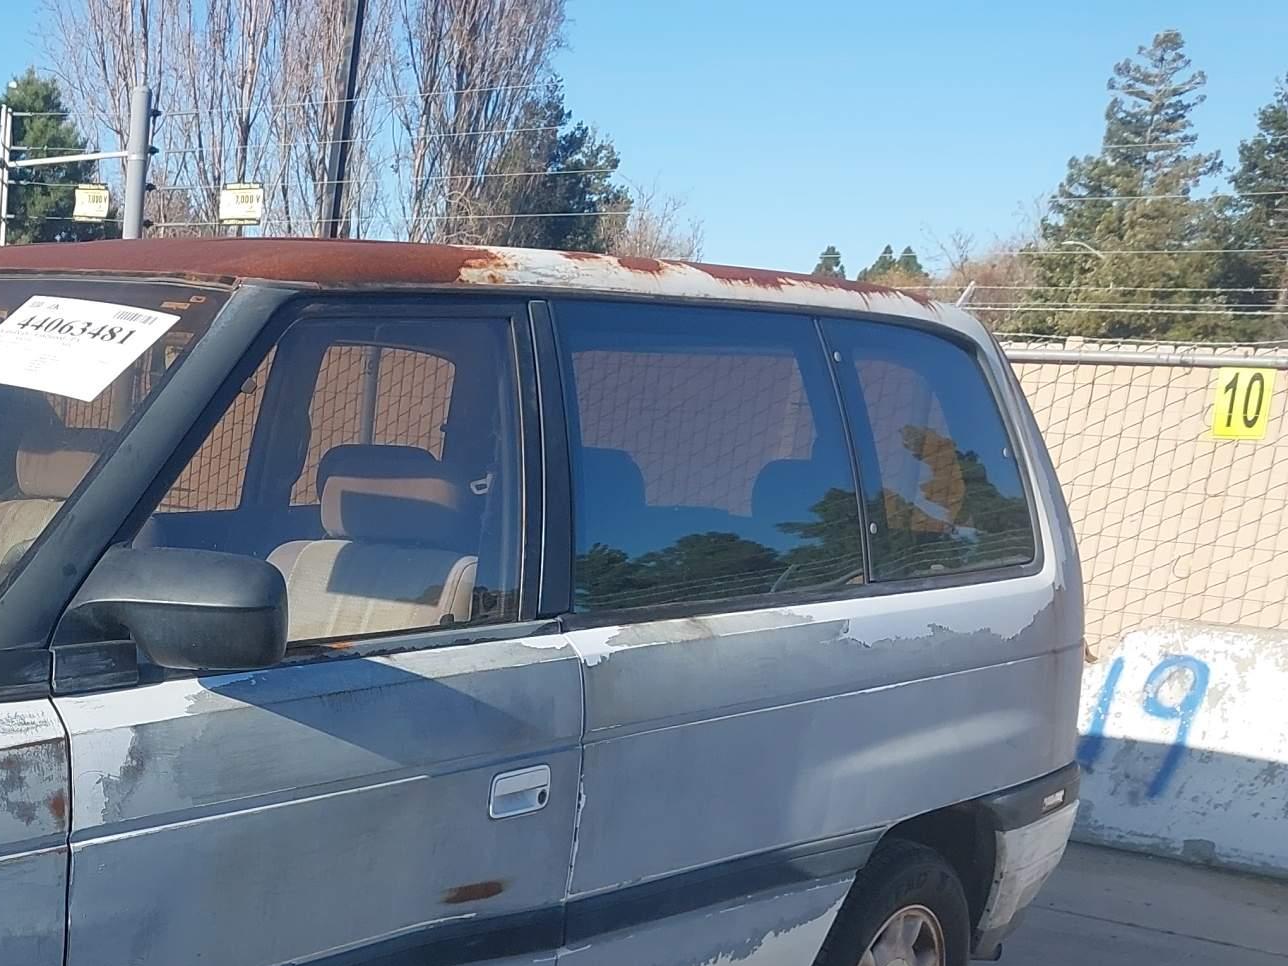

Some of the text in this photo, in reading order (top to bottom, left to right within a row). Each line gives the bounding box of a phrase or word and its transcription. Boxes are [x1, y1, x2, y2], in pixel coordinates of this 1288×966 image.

[17, 315, 136, 345] 44063481
[1223, 371, 1265, 429] 10
[1076, 653, 1211, 799] 19
